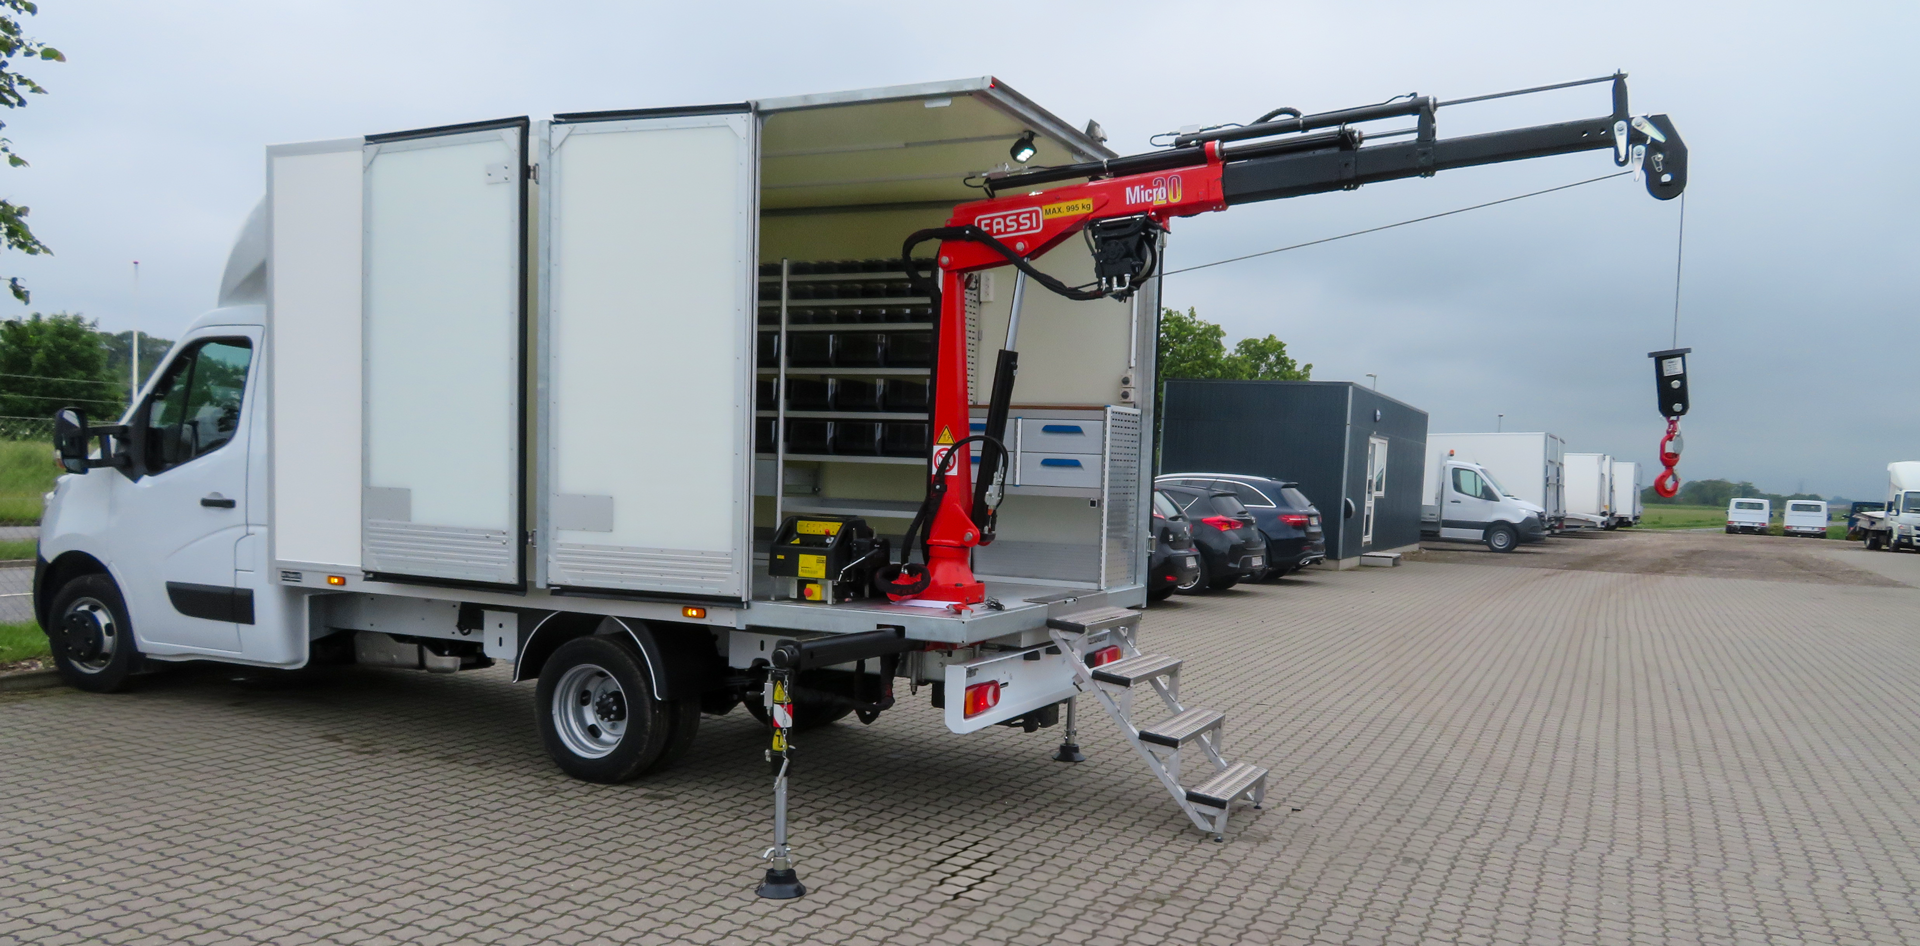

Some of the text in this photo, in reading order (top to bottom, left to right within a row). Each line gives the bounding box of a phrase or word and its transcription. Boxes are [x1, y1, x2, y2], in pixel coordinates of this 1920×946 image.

[1125, 174, 1182, 206] Micro 20
[1044, 202, 1091, 216] MAX. 995 kg
[980, 212, 1037, 234] FASSI
